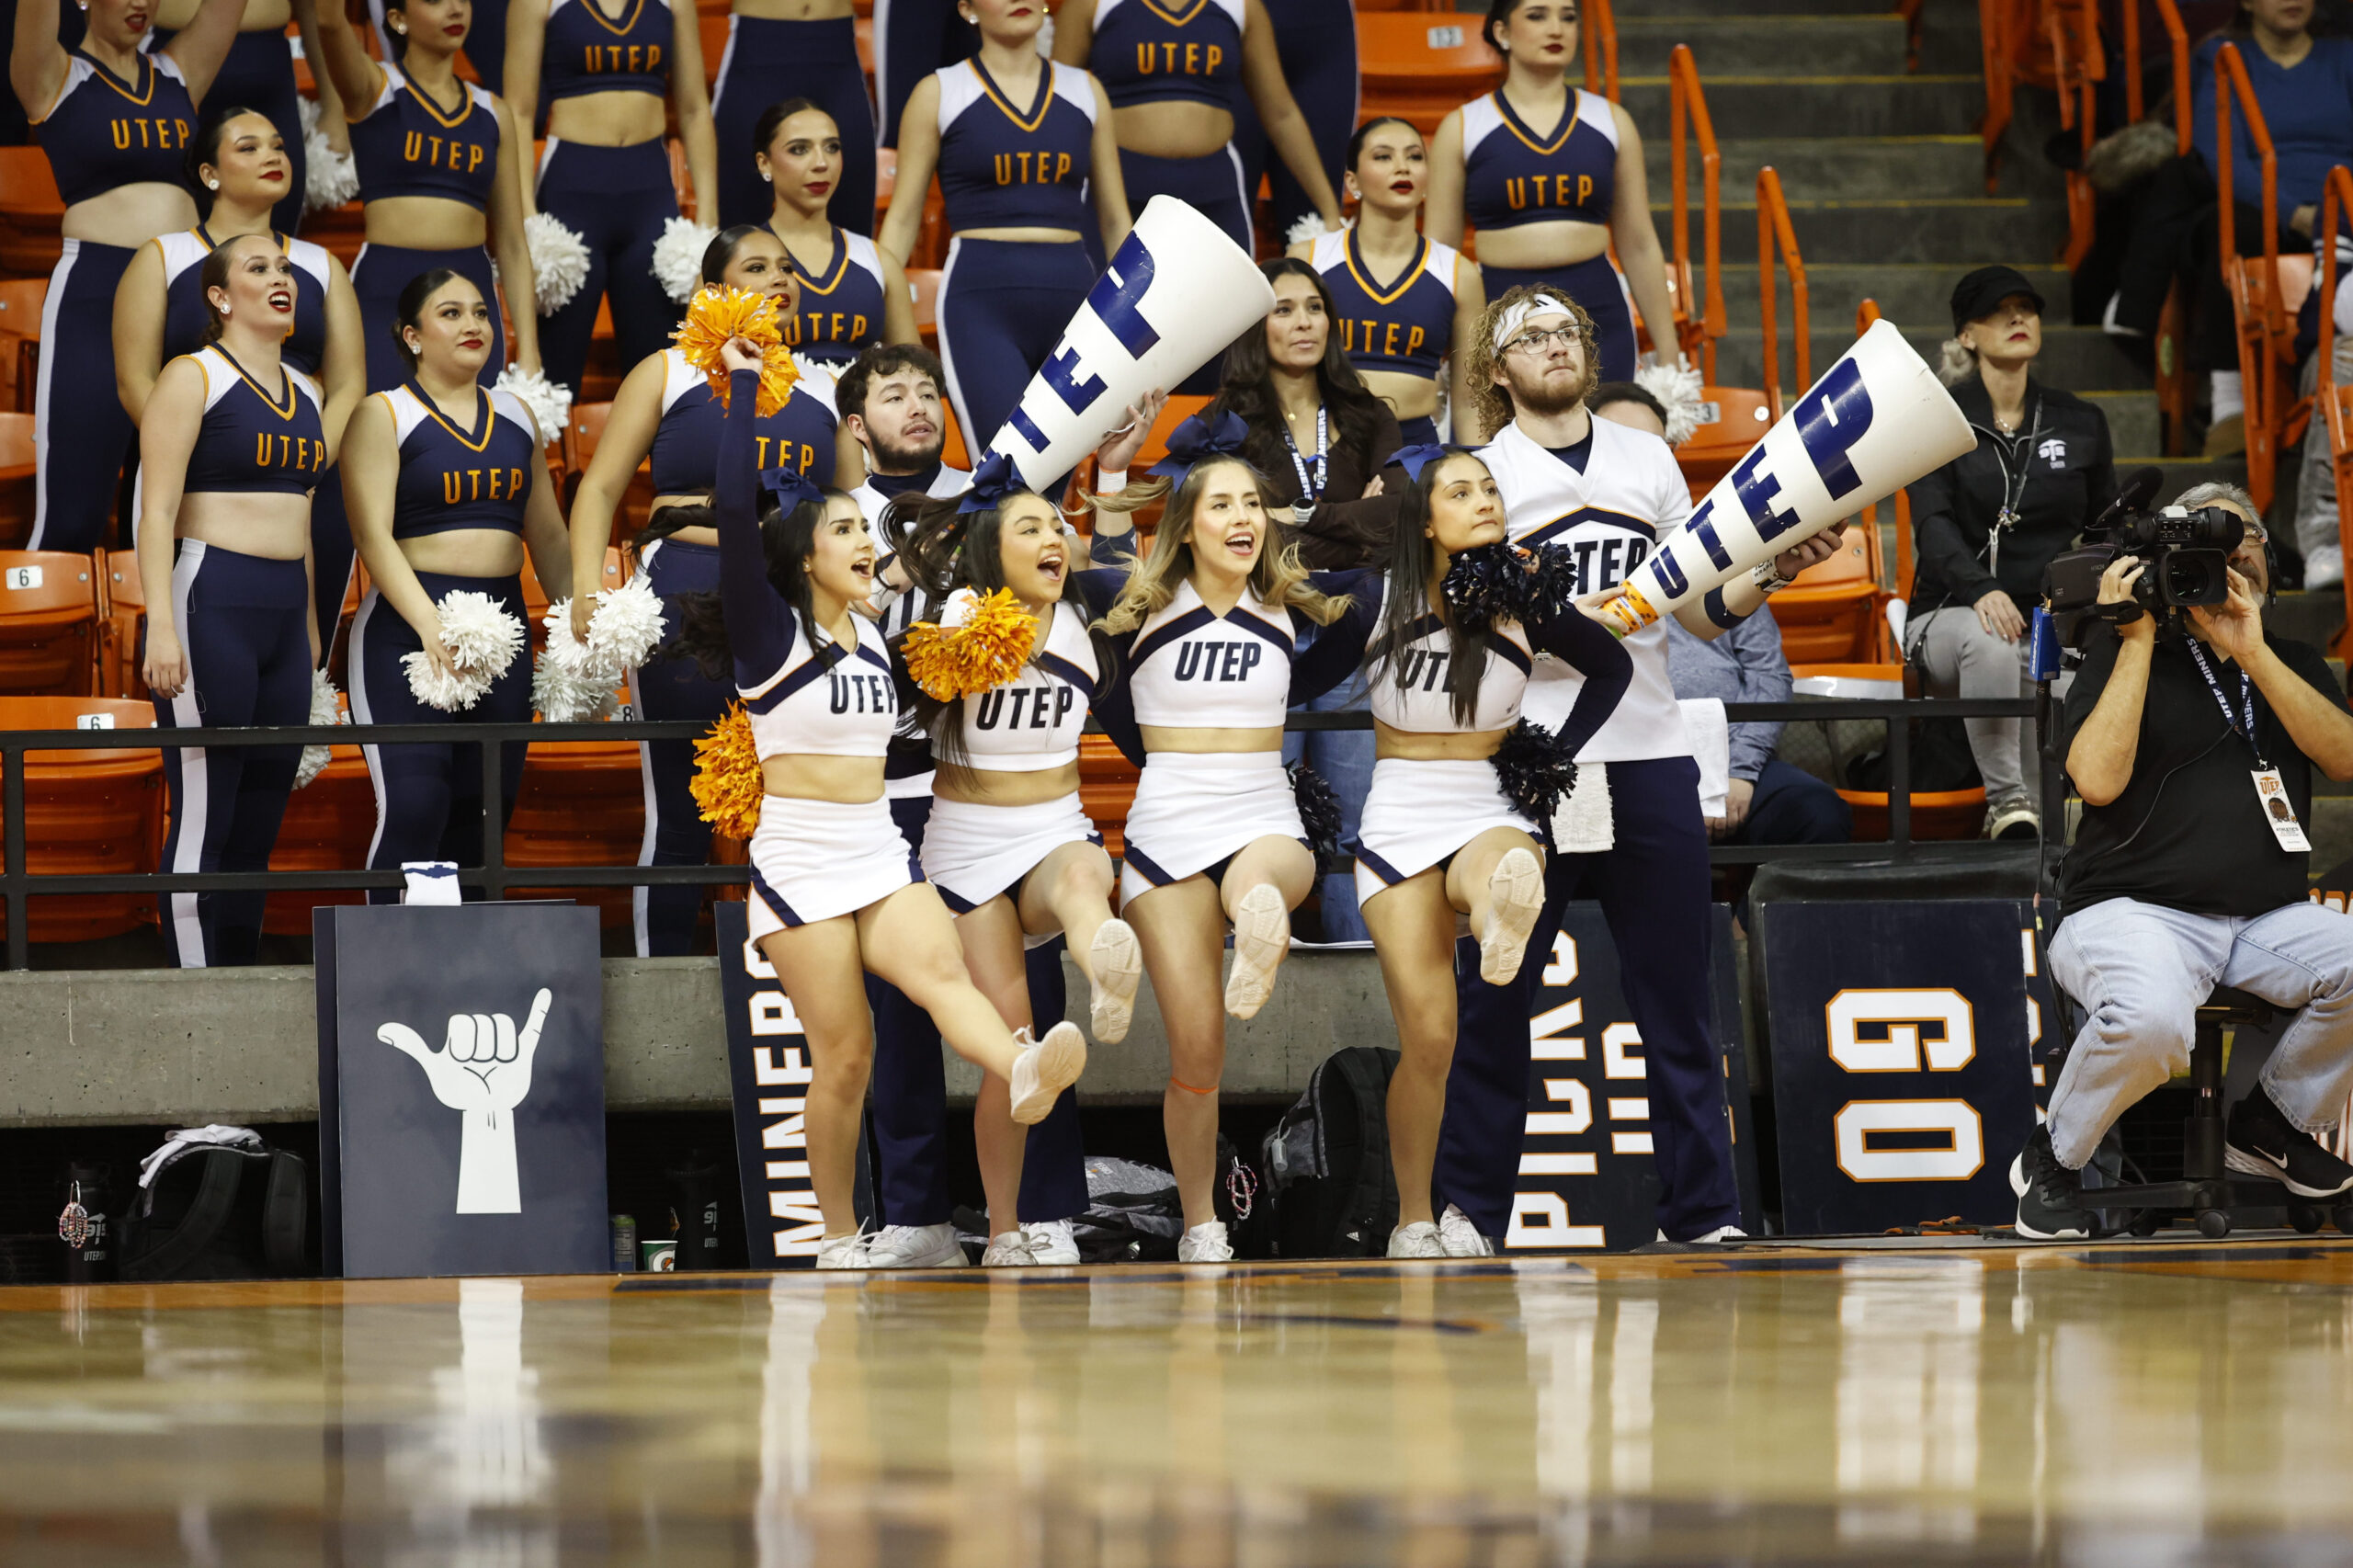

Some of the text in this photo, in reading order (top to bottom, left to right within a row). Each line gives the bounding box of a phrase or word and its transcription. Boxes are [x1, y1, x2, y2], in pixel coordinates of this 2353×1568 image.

[585, 44, 661, 73] UTEP
[1137, 41, 1222, 75] UTEP
[110, 118, 189, 150] UTEP
[404, 131, 483, 173] UTEP
[994, 151, 1072, 185] UTEP
[1506, 174, 1593, 210] UTEP
[1338, 318, 1425, 357] UTEP
[256, 432, 324, 472] UTEP
[1317, 408, 1327, 458] MINERS
[756, 437, 814, 476] TEP
[442, 468, 523, 505] UTEP
[1650, 358, 1873, 599] UTEP
[18, 568, 29, 587] 6
[1557, 538, 1648, 596] TEP
[1174, 641, 1262, 682] UTEP
[2188, 638, 2234, 719] UTEP MINERS
[622, 705, 633, 722] 8
[829, 674, 895, 715] UTEP
[976, 686, 1074, 731] UTEP
[2259, 777, 2279, 795] UTEP
[1824, 987, 1985, 1183] GO
